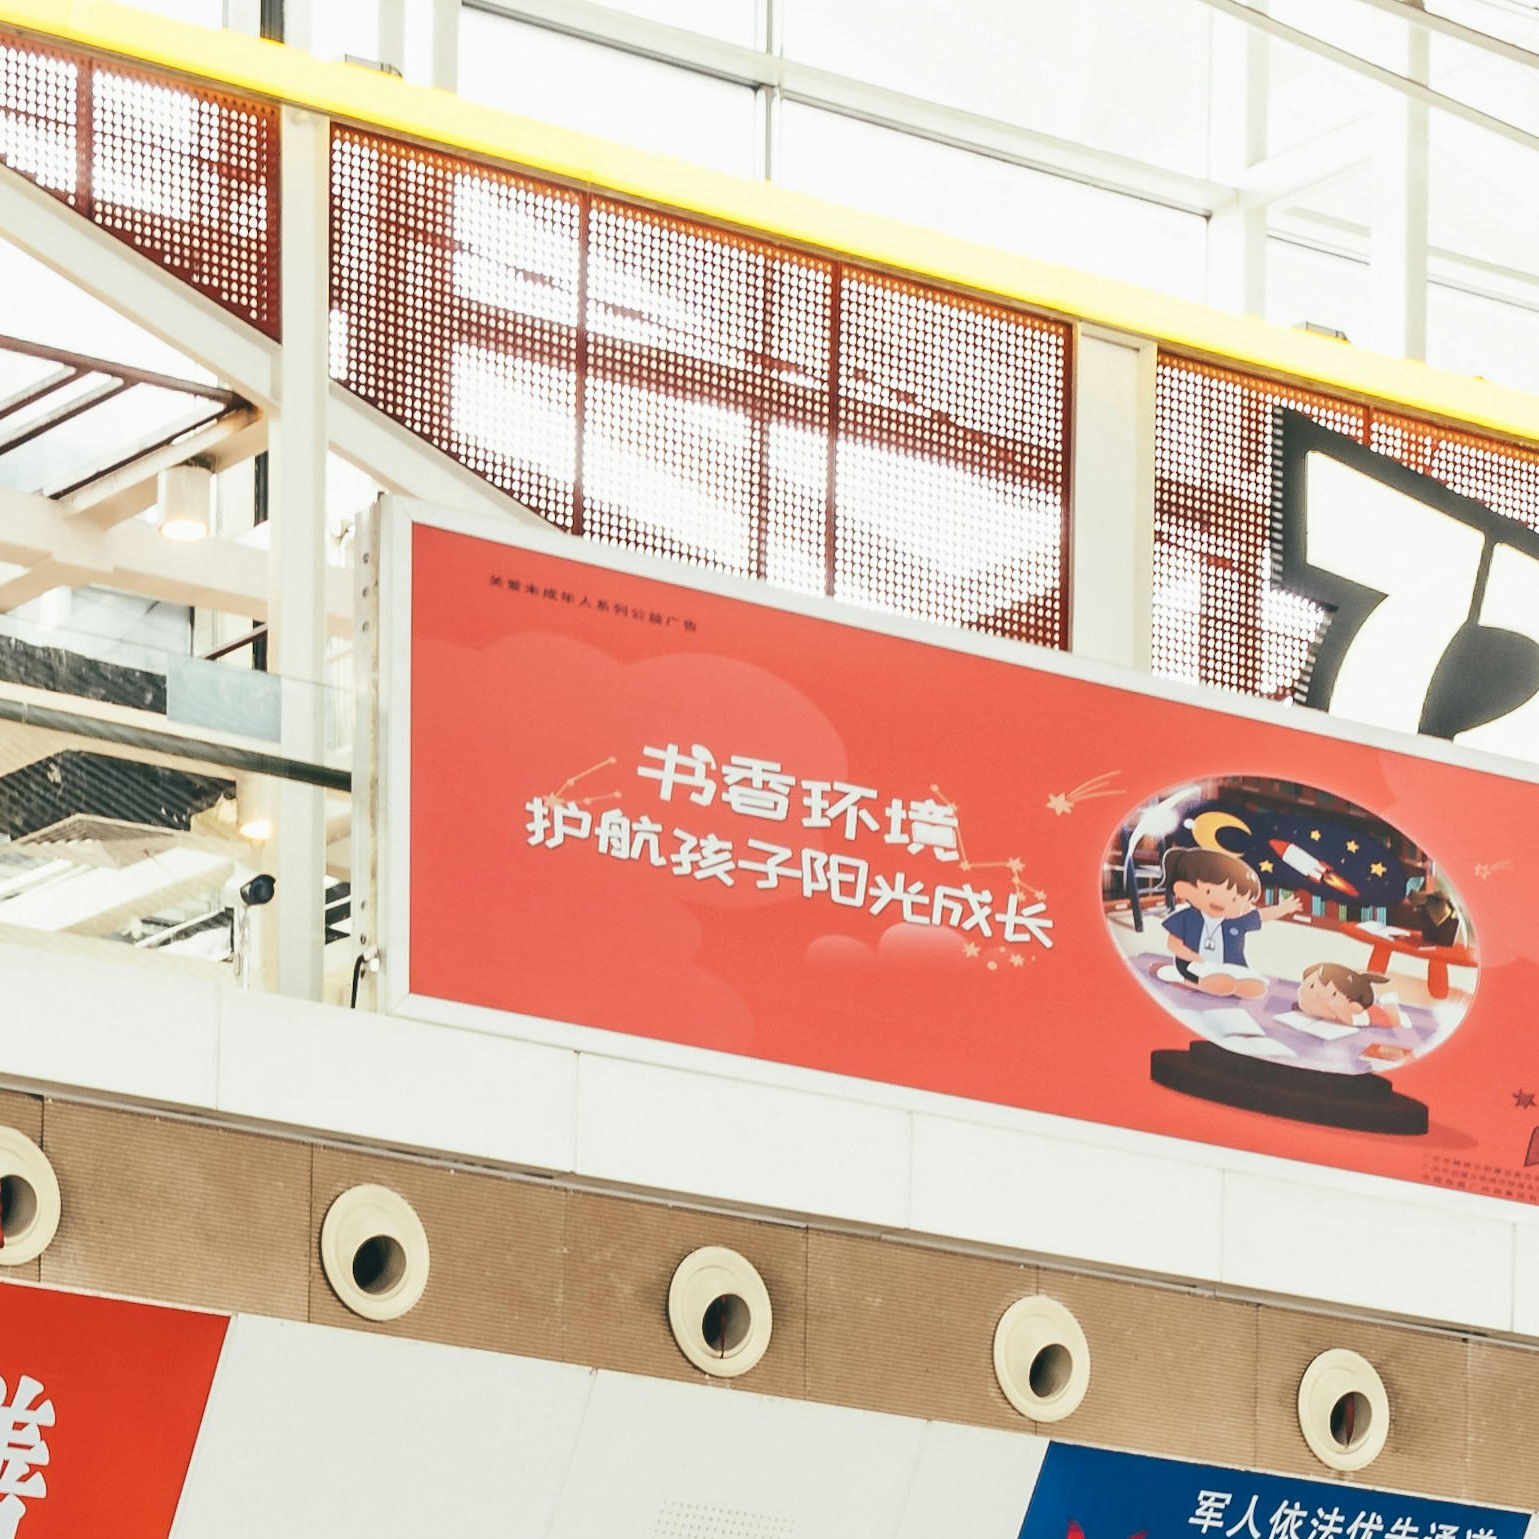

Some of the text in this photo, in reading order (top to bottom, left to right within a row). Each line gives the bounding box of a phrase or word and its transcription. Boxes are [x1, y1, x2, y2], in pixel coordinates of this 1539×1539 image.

[637, 743, 960, 862] 书香环境
[525, 796, 1054, 948] 护航孩子阳光成长
